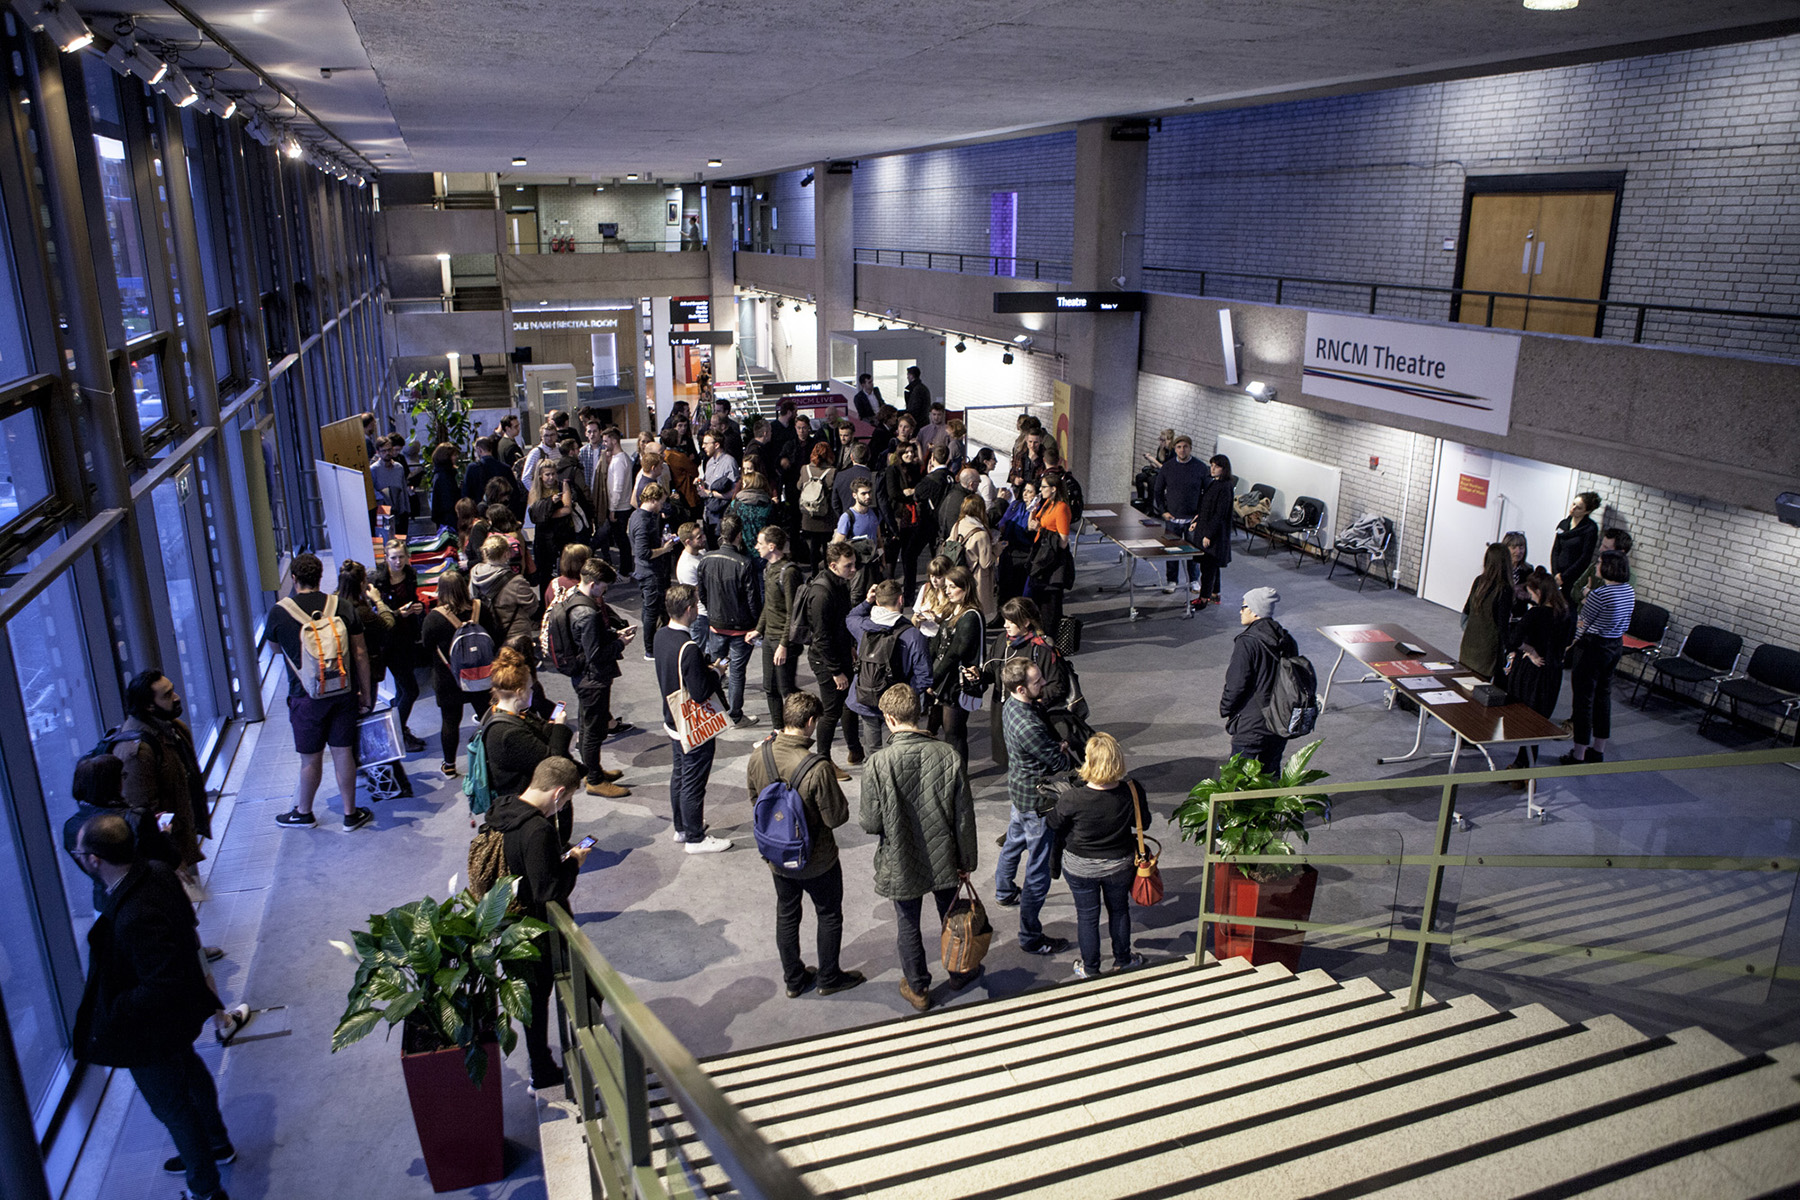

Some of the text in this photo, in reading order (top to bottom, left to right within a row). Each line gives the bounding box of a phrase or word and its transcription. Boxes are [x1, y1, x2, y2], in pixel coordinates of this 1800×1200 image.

[1056, 296, 1087, 307] Theatre
[557, 319, 590, 330] RECITAL
[591, 319, 618, 328] ROOM
[1316, 337, 1446, 379] RNCM Theatre
[795, 383, 822, 392] Upper Hall
[815, 396, 834, 404] LIVE
[685, 702, 716, 731] TAKES
[687, 713, 727, 748] LONDON
